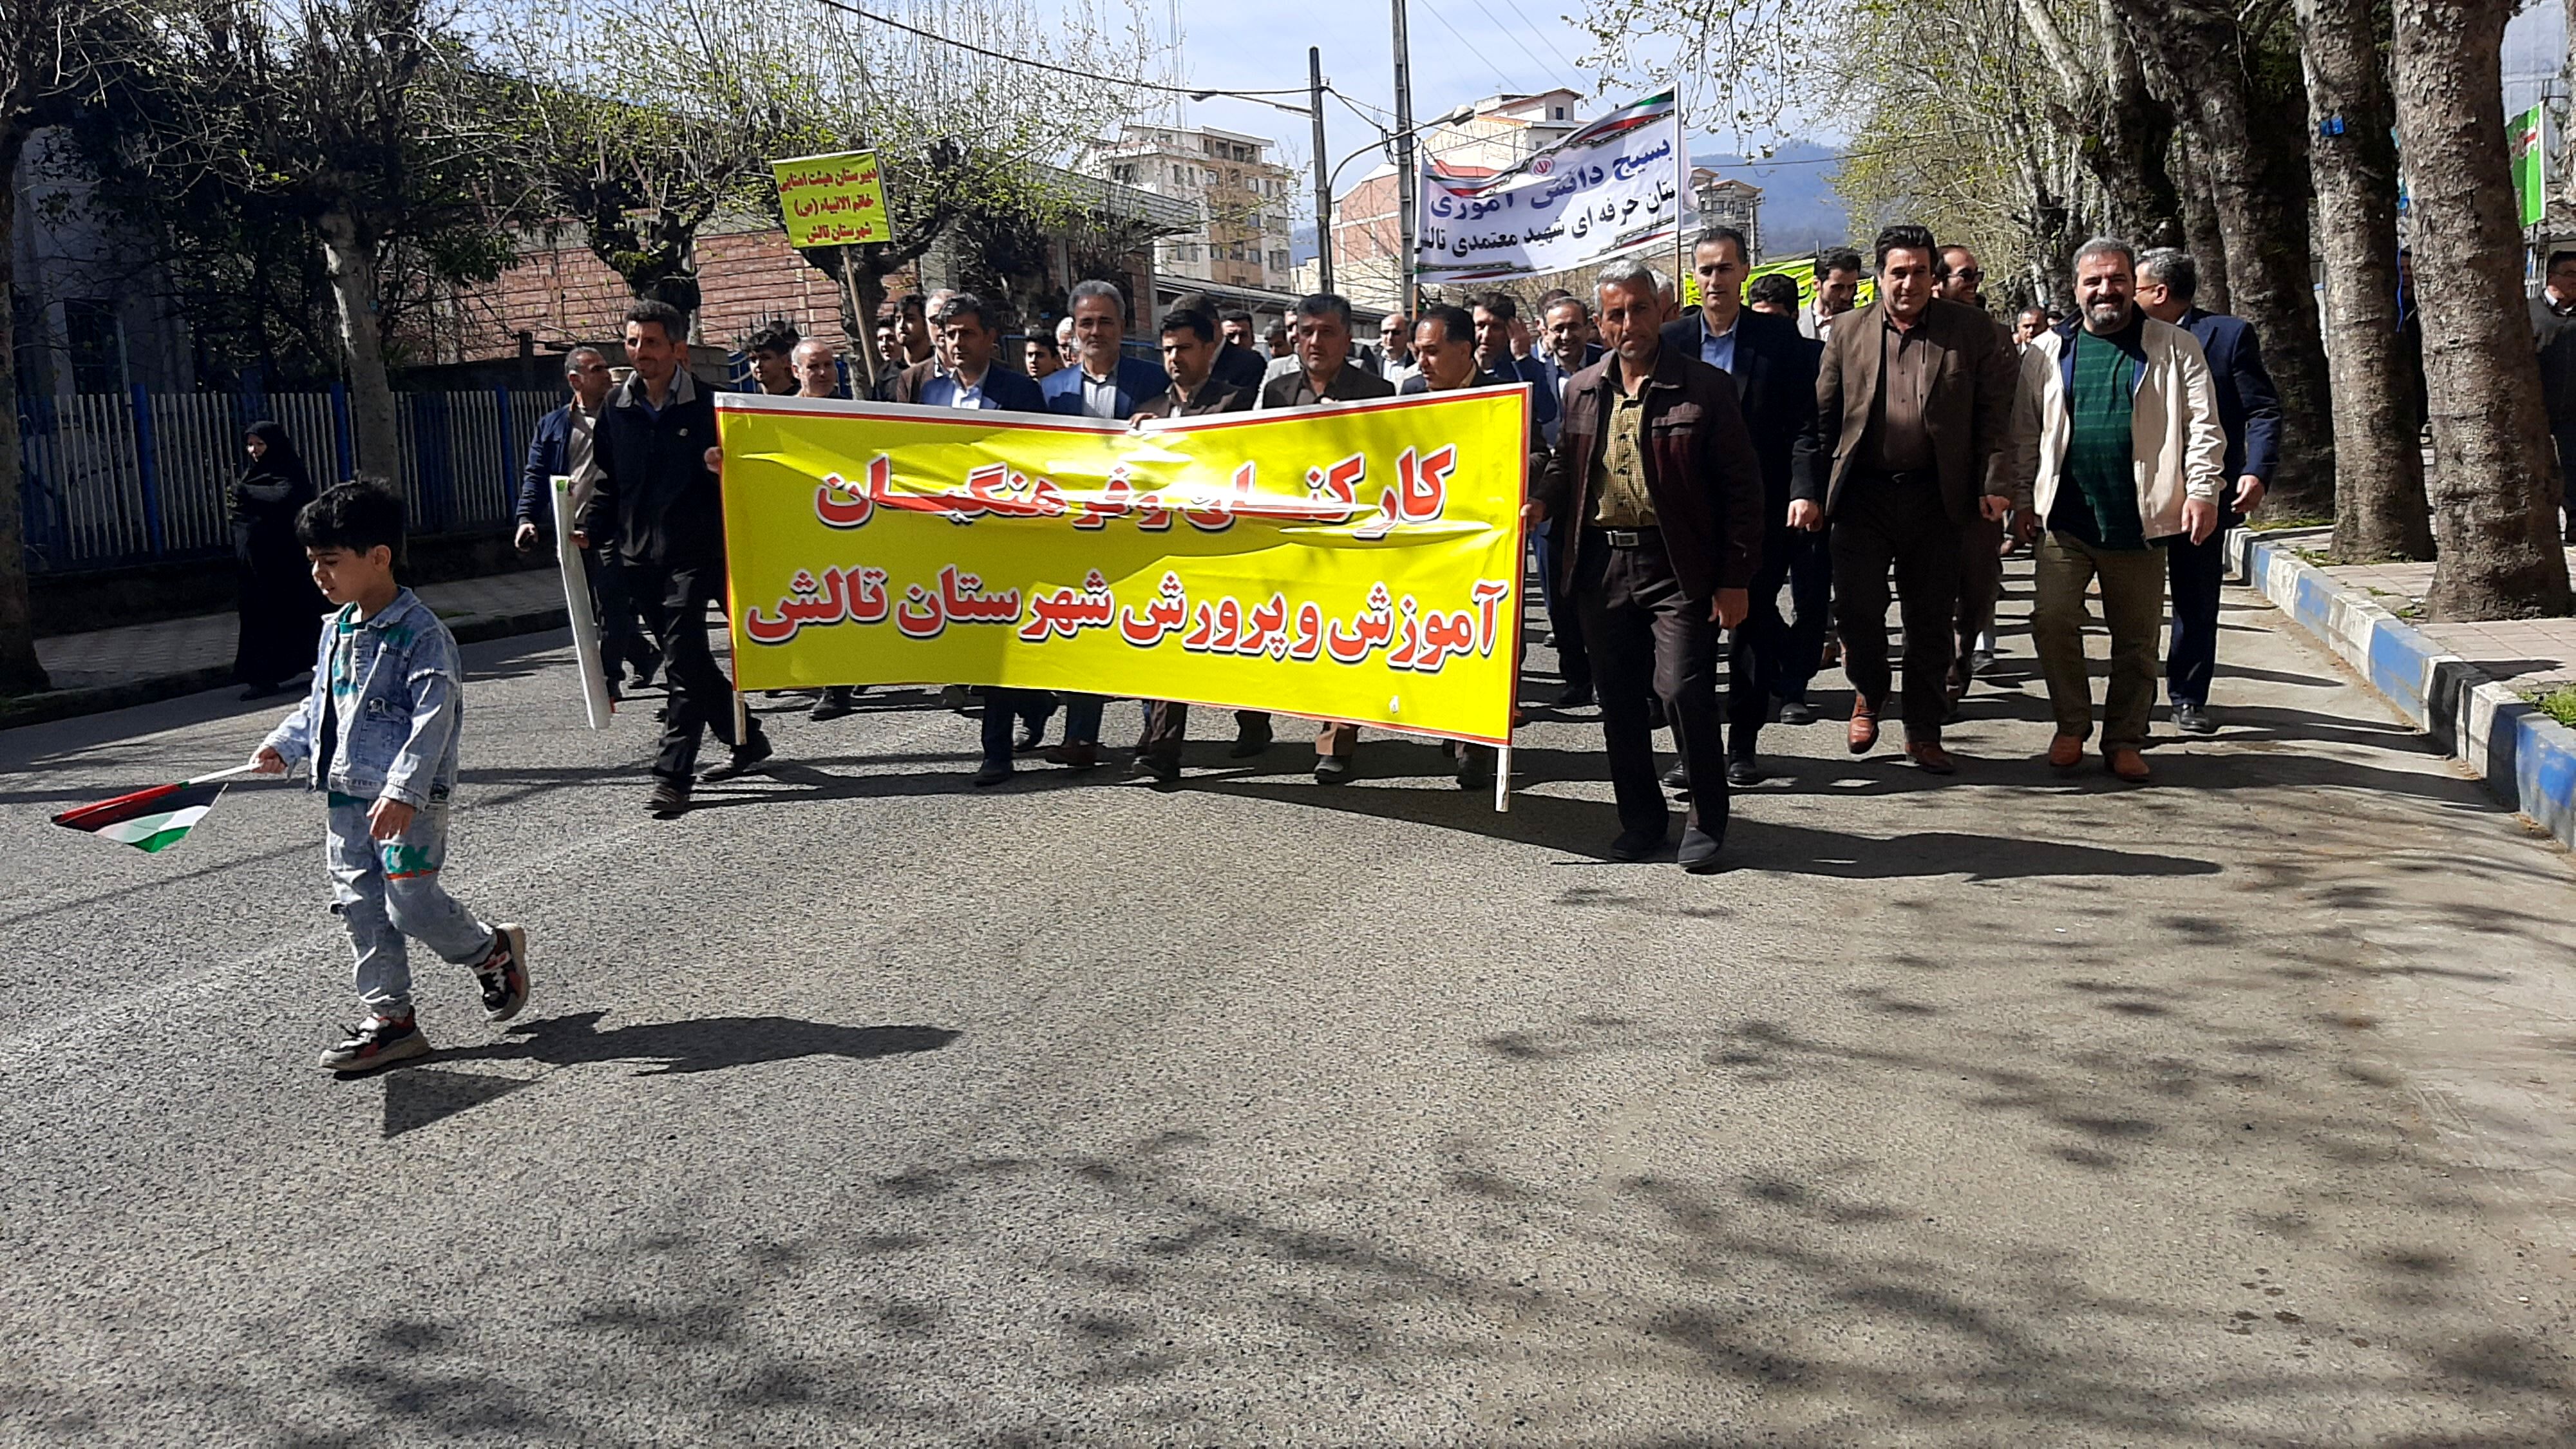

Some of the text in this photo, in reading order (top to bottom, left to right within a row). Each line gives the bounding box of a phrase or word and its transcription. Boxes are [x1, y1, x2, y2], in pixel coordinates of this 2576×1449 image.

[1613, 139, 1672, 180] بسیج
[835, 167, 878, 187] دبیرستان
[1531, 166, 1604, 209] دانش
[1572, 206, 1593, 238] ای
[1599, 197, 1639, 226] حرفه
[807, 222, 872, 243] شهرستان تالش
[1452, 232, 1518, 257] معتمدی
[1524, 216, 1564, 247] شهید
[745, 564, 1508, 671] آموزش و پرورش شهرستان تالش
